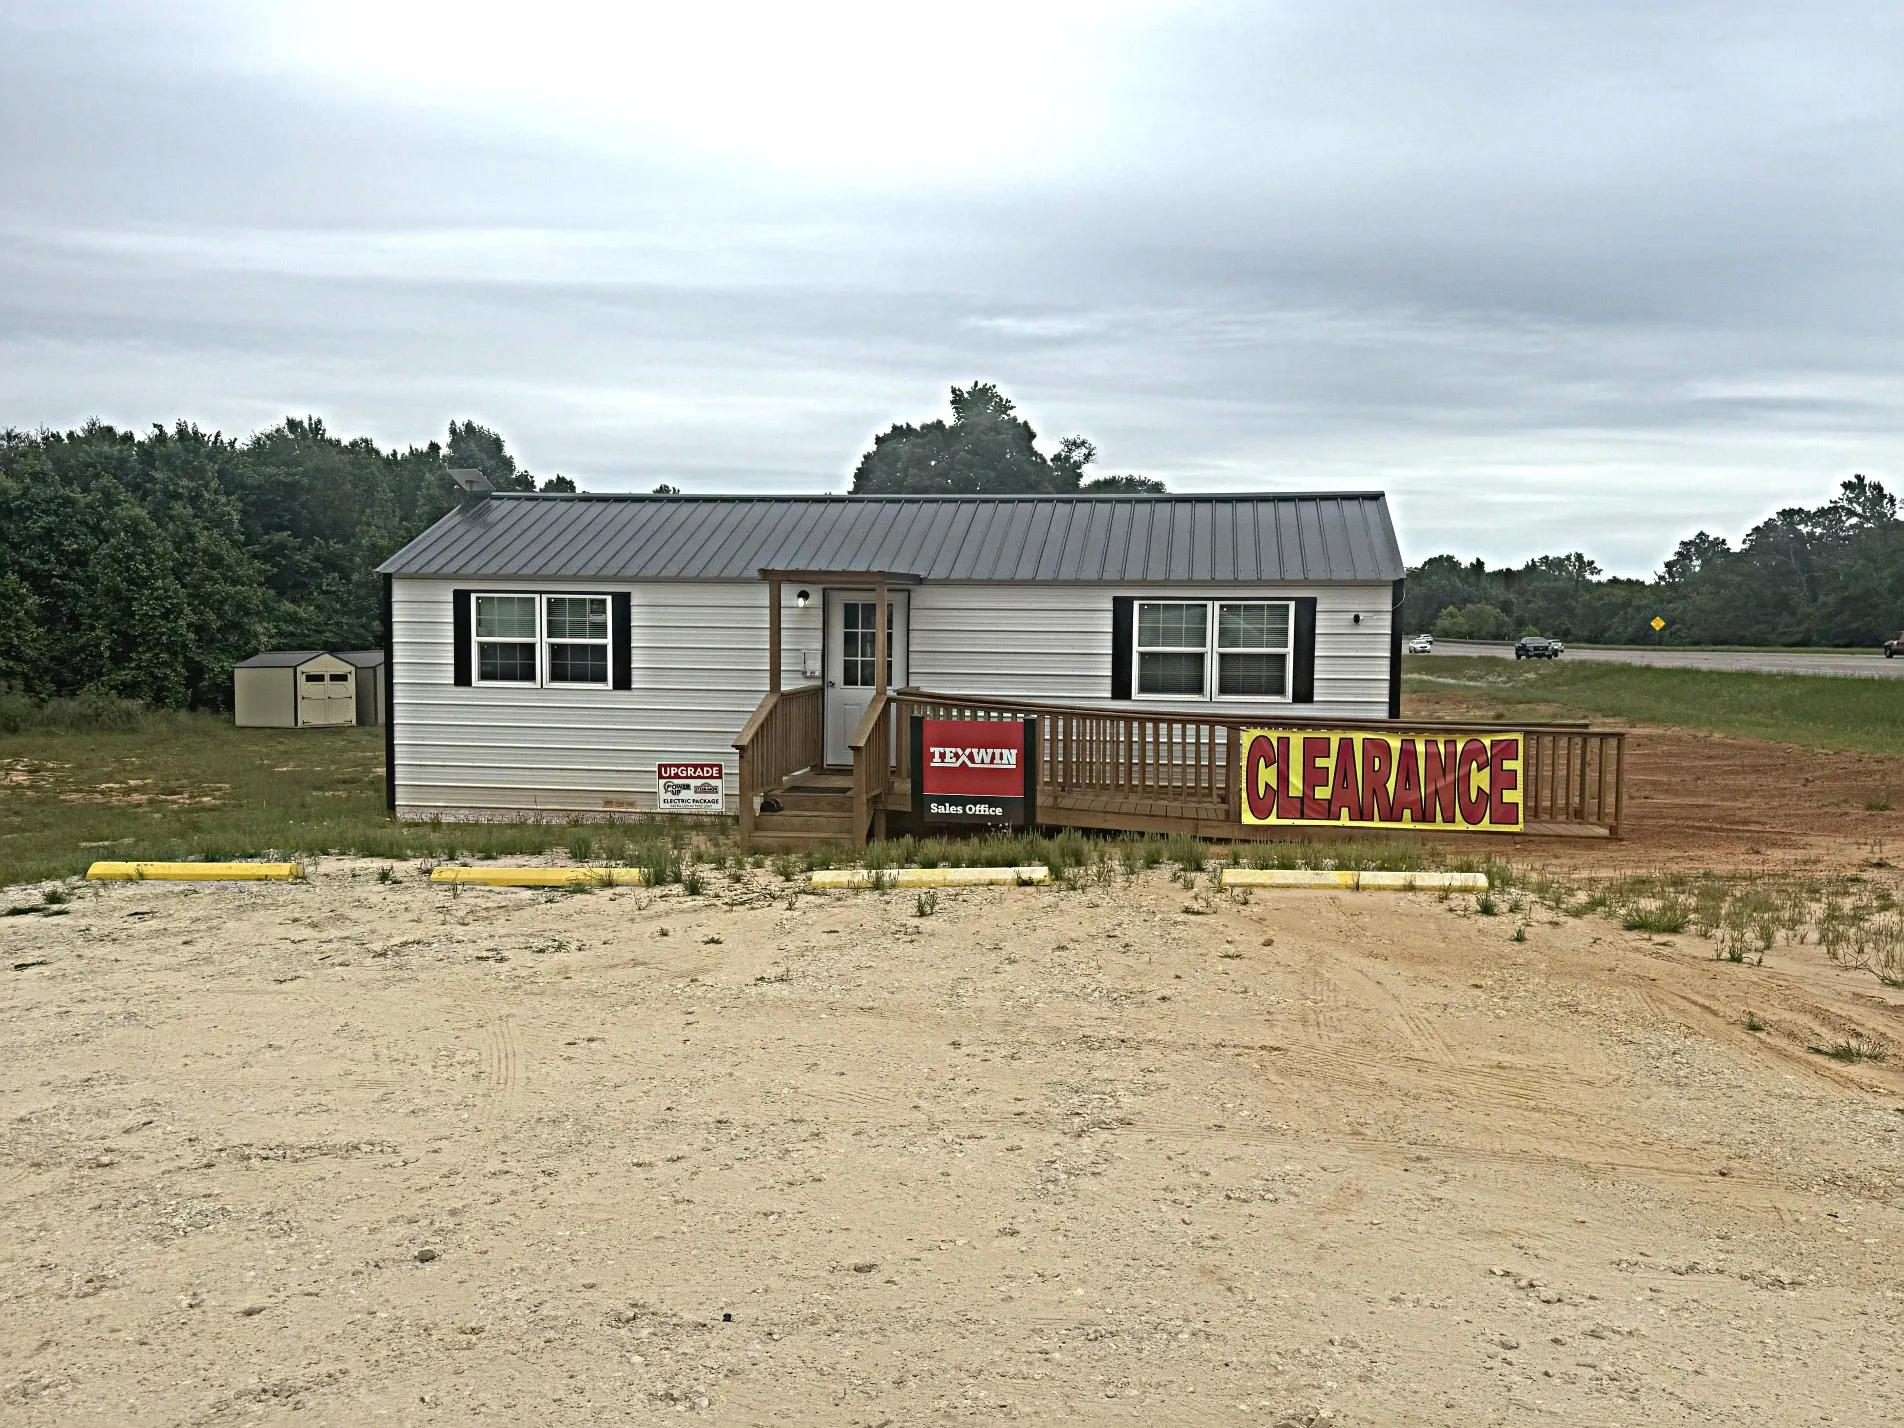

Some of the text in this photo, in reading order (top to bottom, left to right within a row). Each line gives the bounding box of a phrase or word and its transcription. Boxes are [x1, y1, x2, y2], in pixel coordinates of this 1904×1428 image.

[930, 747, 1017, 768] TEXWIN
[661, 767, 720, 777] UPGRADE
[1246, 735, 1518, 825] CLEARANCE
[930, 803, 1003, 815] Sales Office
